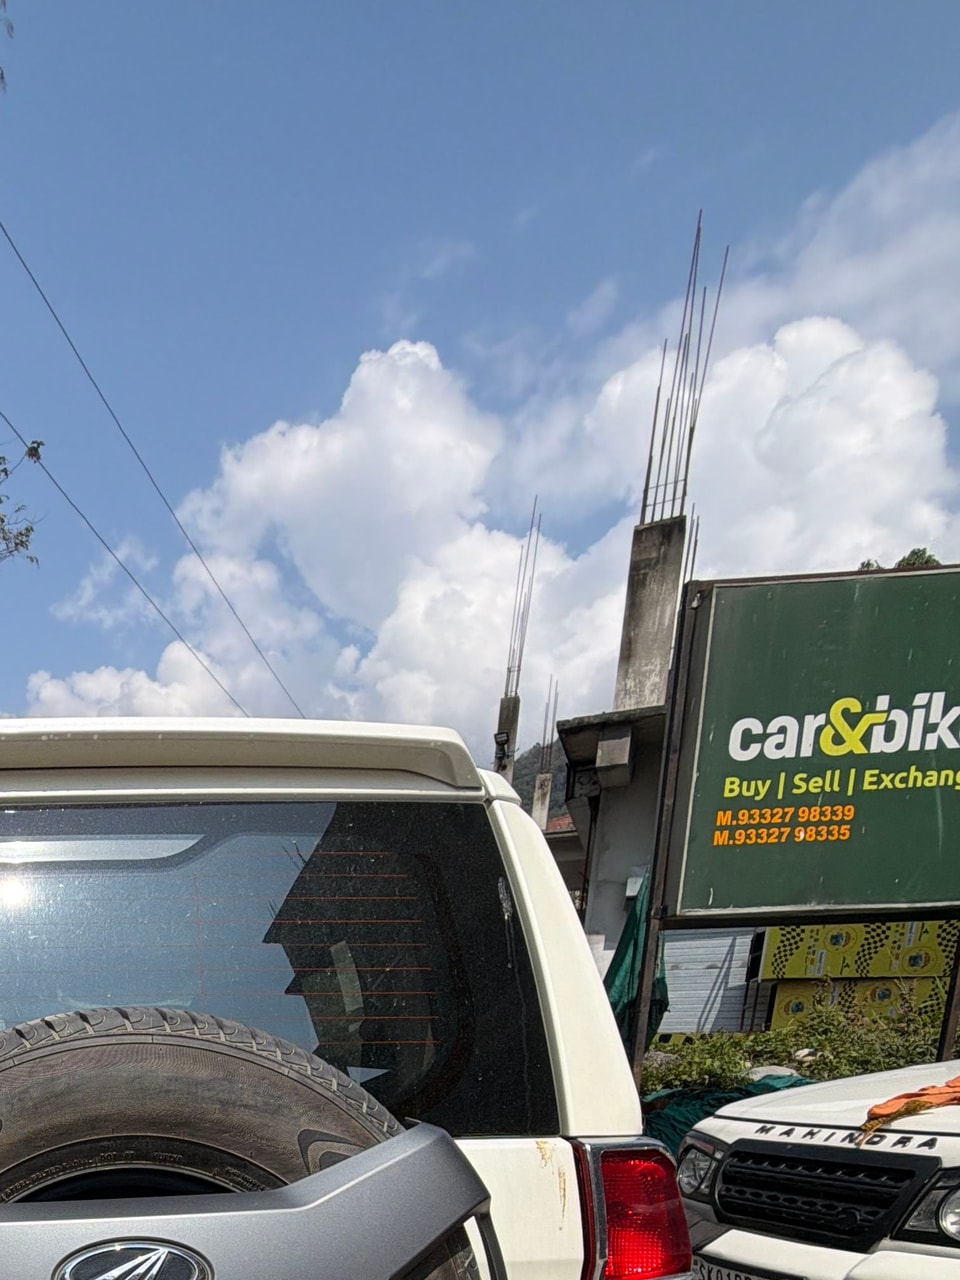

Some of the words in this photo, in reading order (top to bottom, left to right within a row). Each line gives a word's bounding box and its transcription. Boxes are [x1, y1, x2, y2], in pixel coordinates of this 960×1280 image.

[728, 691, 960, 762] car&bik
[723, 777, 772, 801] Buy
[792, 769, 841, 795] Sell
[716, 807, 794, 827] M.93327
[797, 804, 855, 823] 98339
[712, 827, 791, 847] M.93327
[794, 824, 851, 843] 98335
[754, 1125, 938, 1150] MAHINDRA
